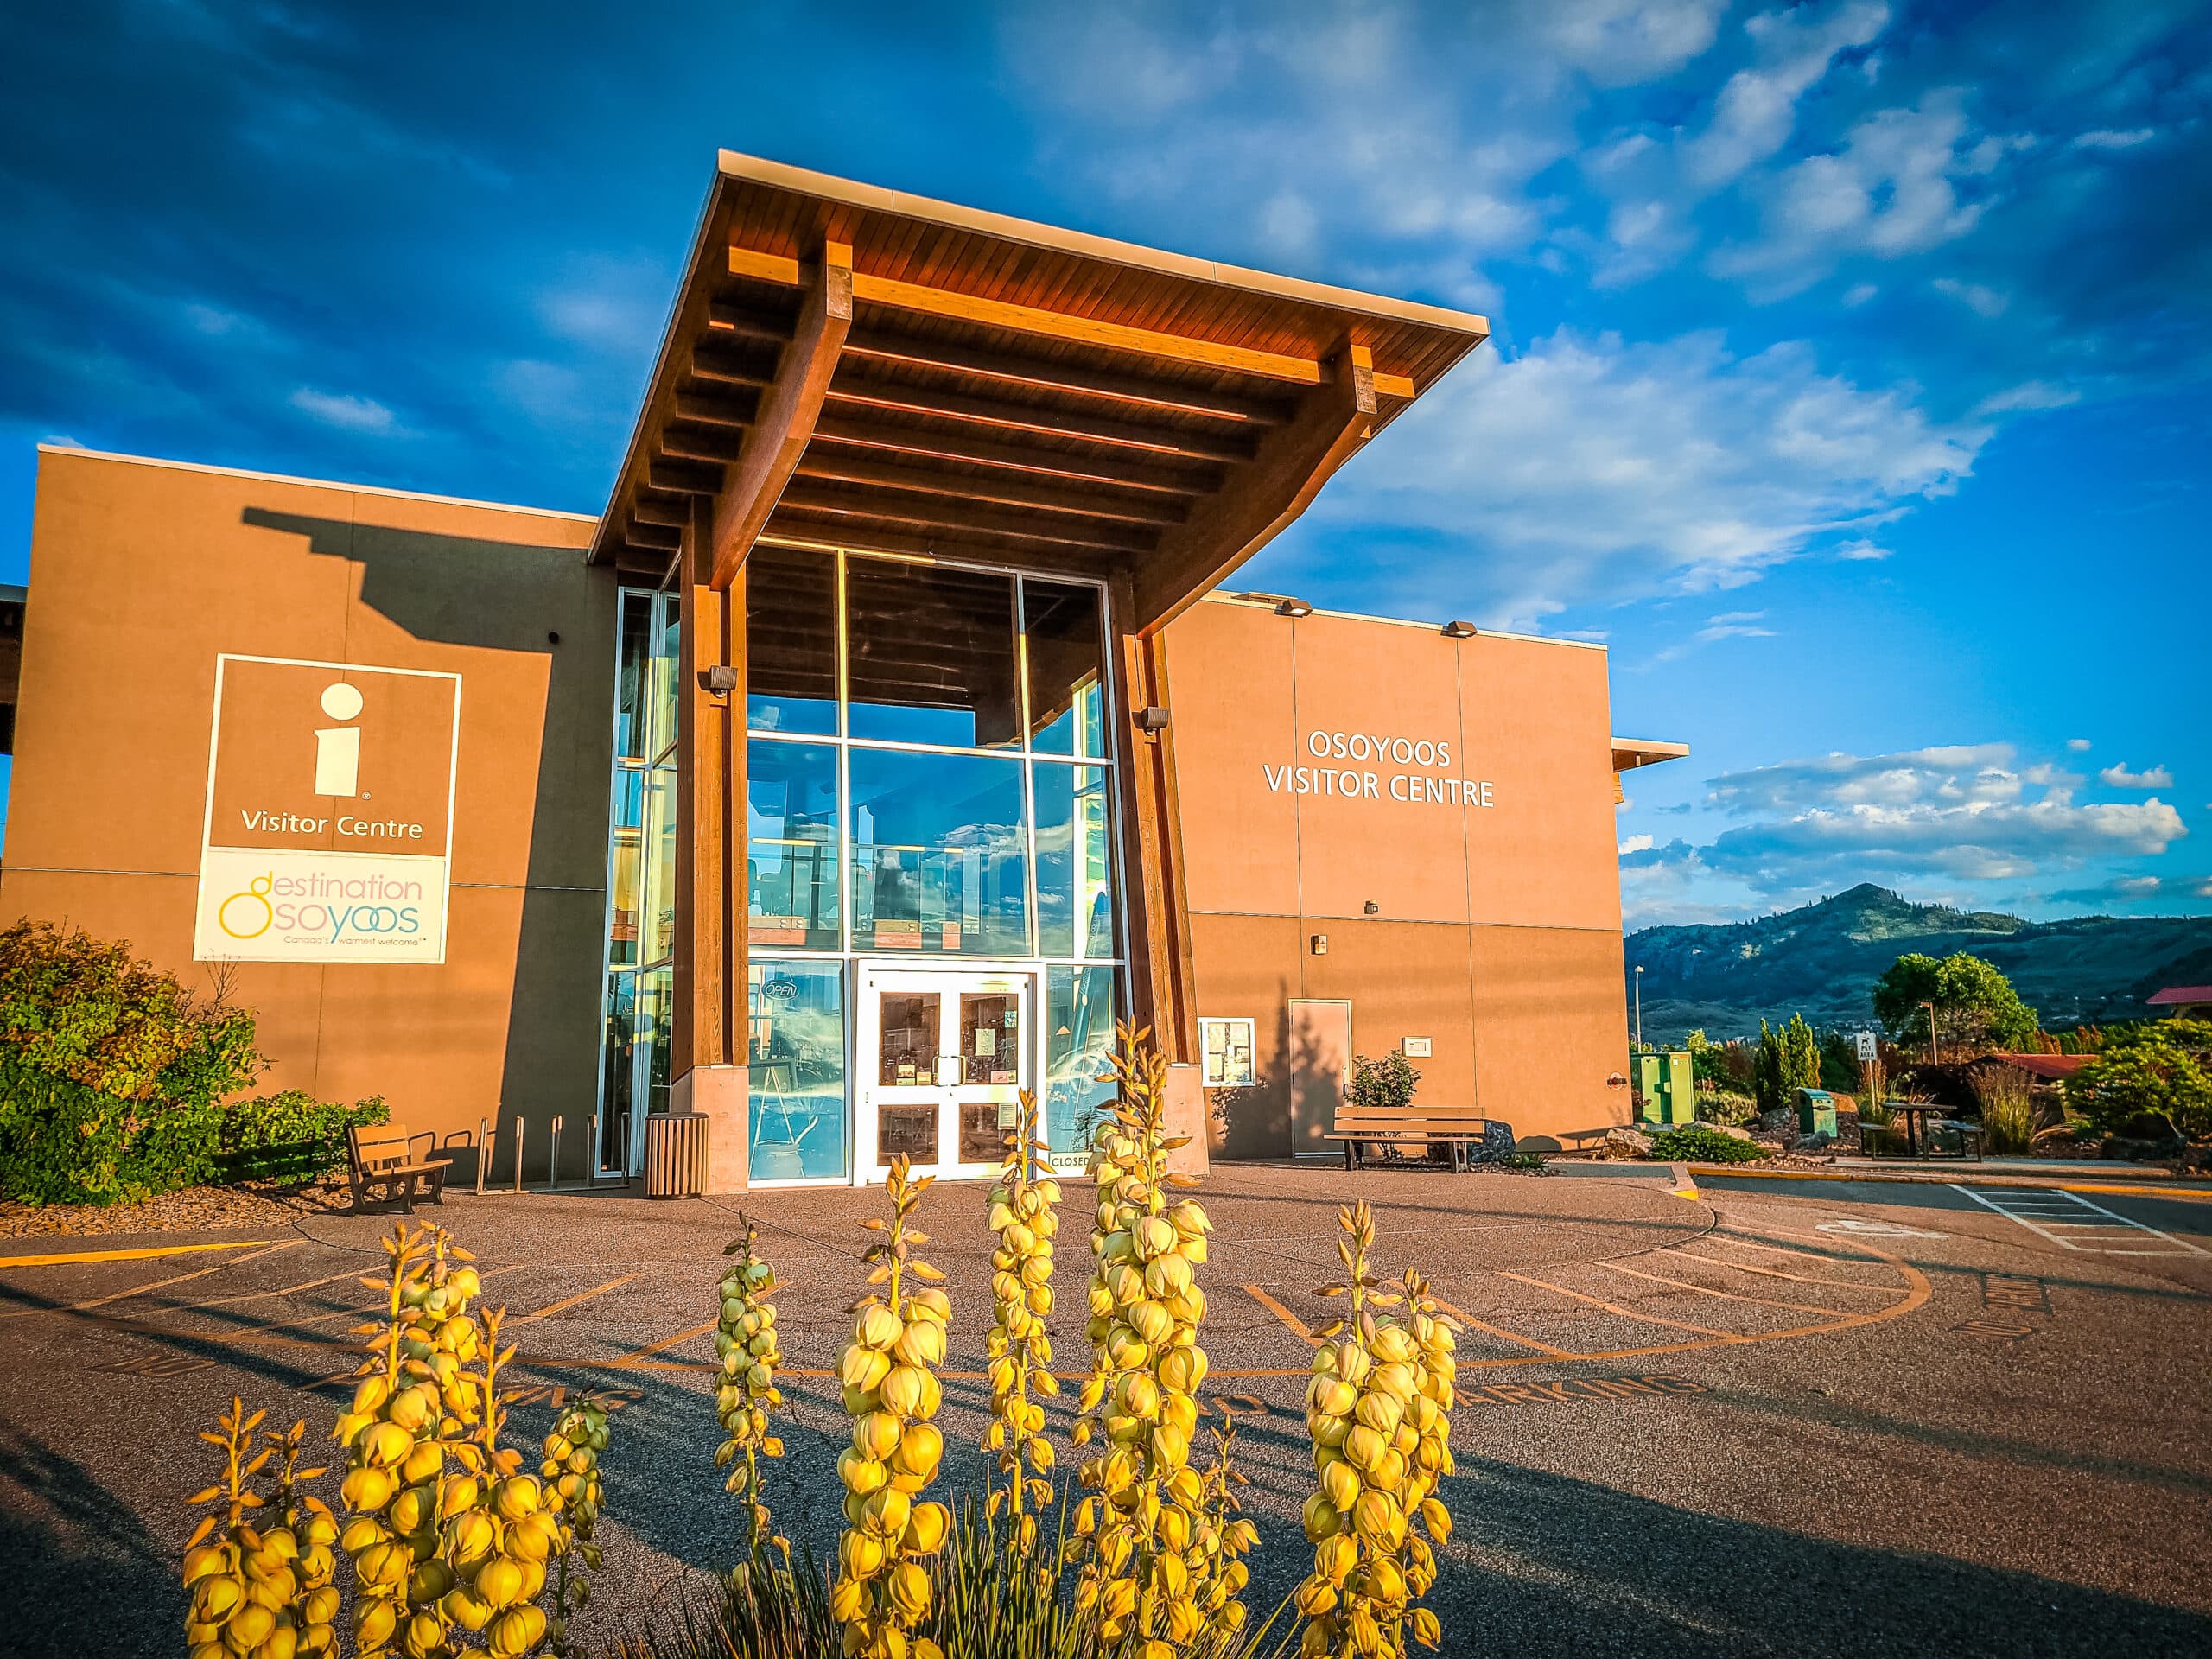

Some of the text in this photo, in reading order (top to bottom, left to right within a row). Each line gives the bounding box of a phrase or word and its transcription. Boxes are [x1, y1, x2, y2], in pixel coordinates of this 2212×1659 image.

[1308, 730, 1450, 767] OSOYOOS
[1262, 764, 1494, 807] VISITOR CENTRE
[241, 810, 423, 839] Visitor Centre
[251, 871, 422, 900] destination
[766, 984, 797, 995] OPEN
[1453, 1376, 1707, 1407] ARKING
